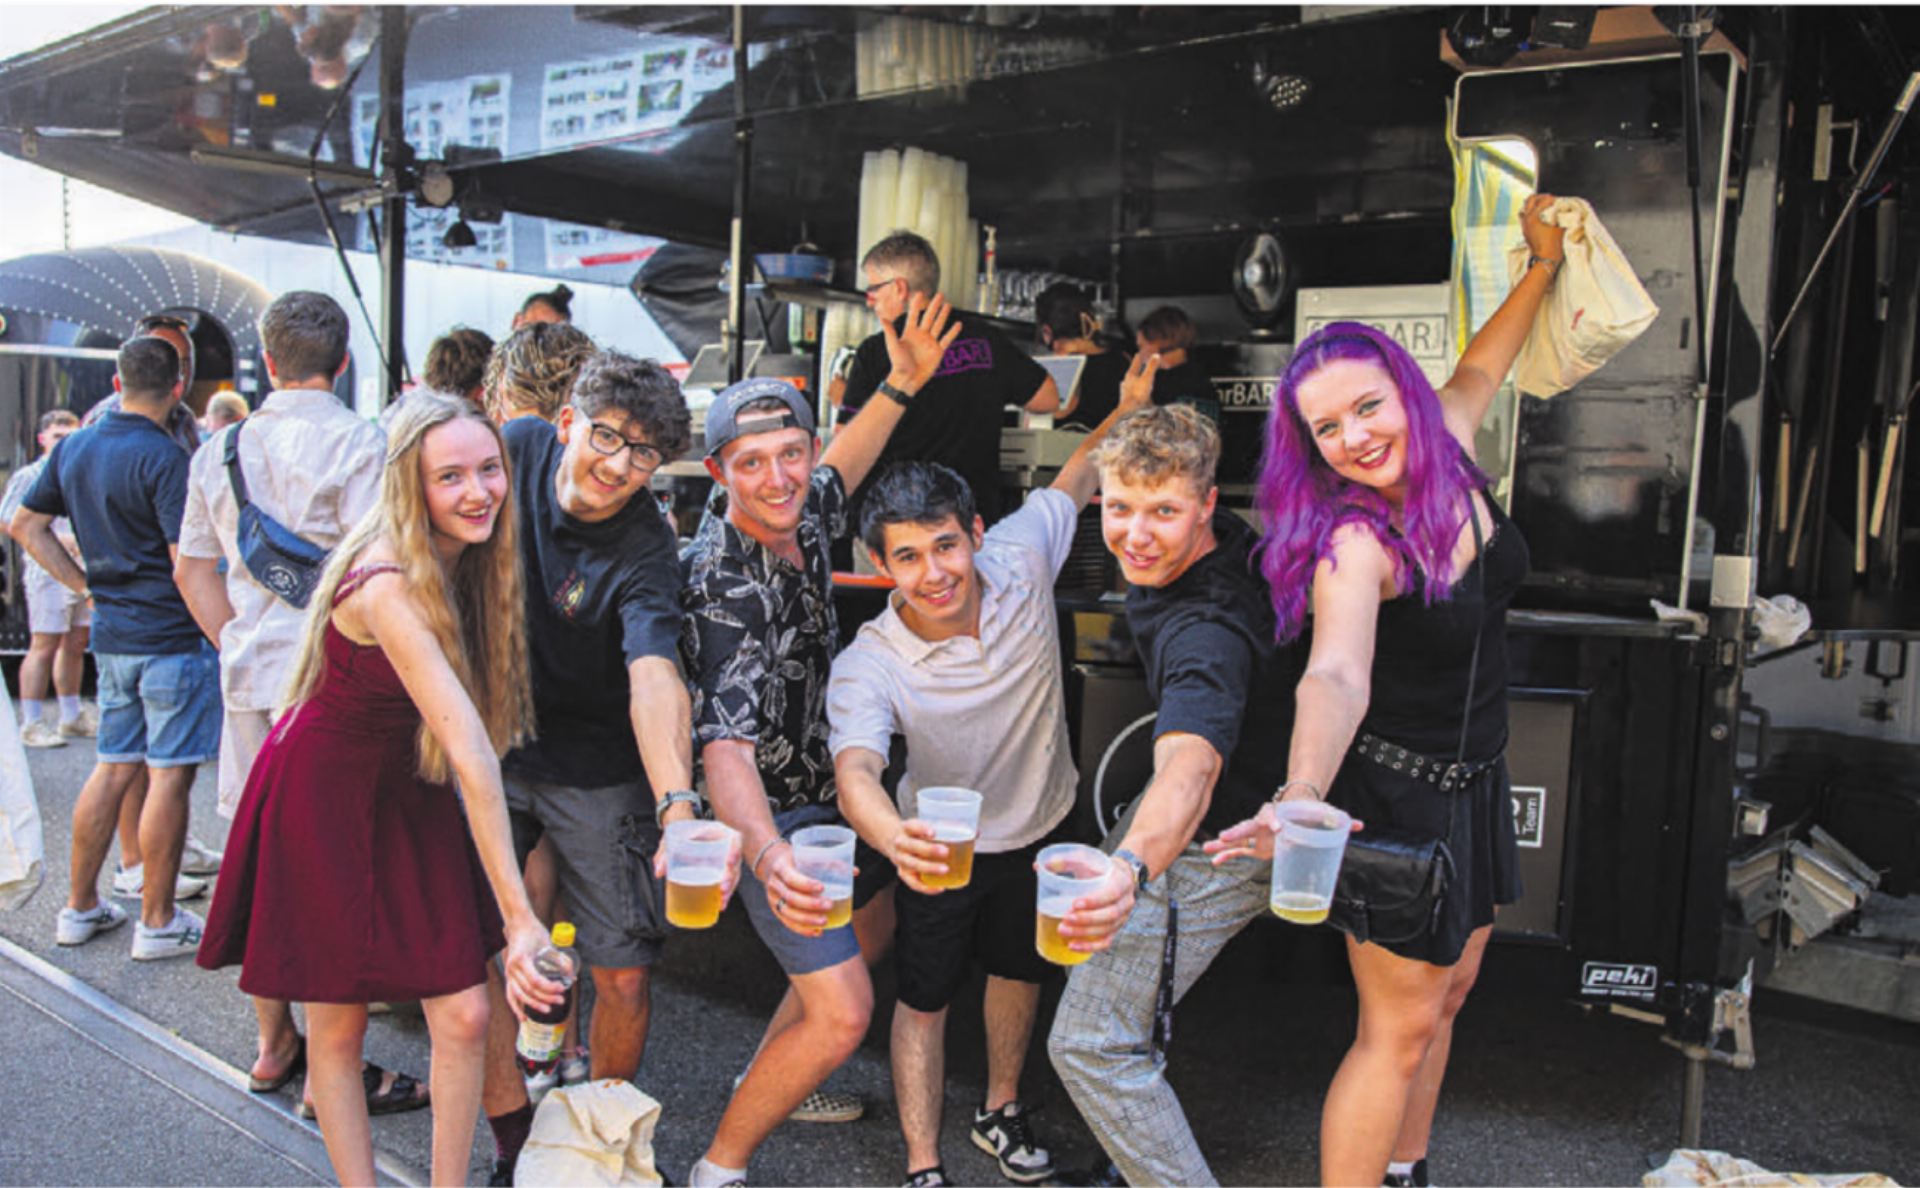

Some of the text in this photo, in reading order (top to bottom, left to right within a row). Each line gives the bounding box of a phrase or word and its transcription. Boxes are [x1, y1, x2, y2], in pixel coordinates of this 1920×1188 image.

[939, 343, 984, 369] BAR
[1522, 797, 1537, 835] Team
[1587, 966, 1651, 986] peki
